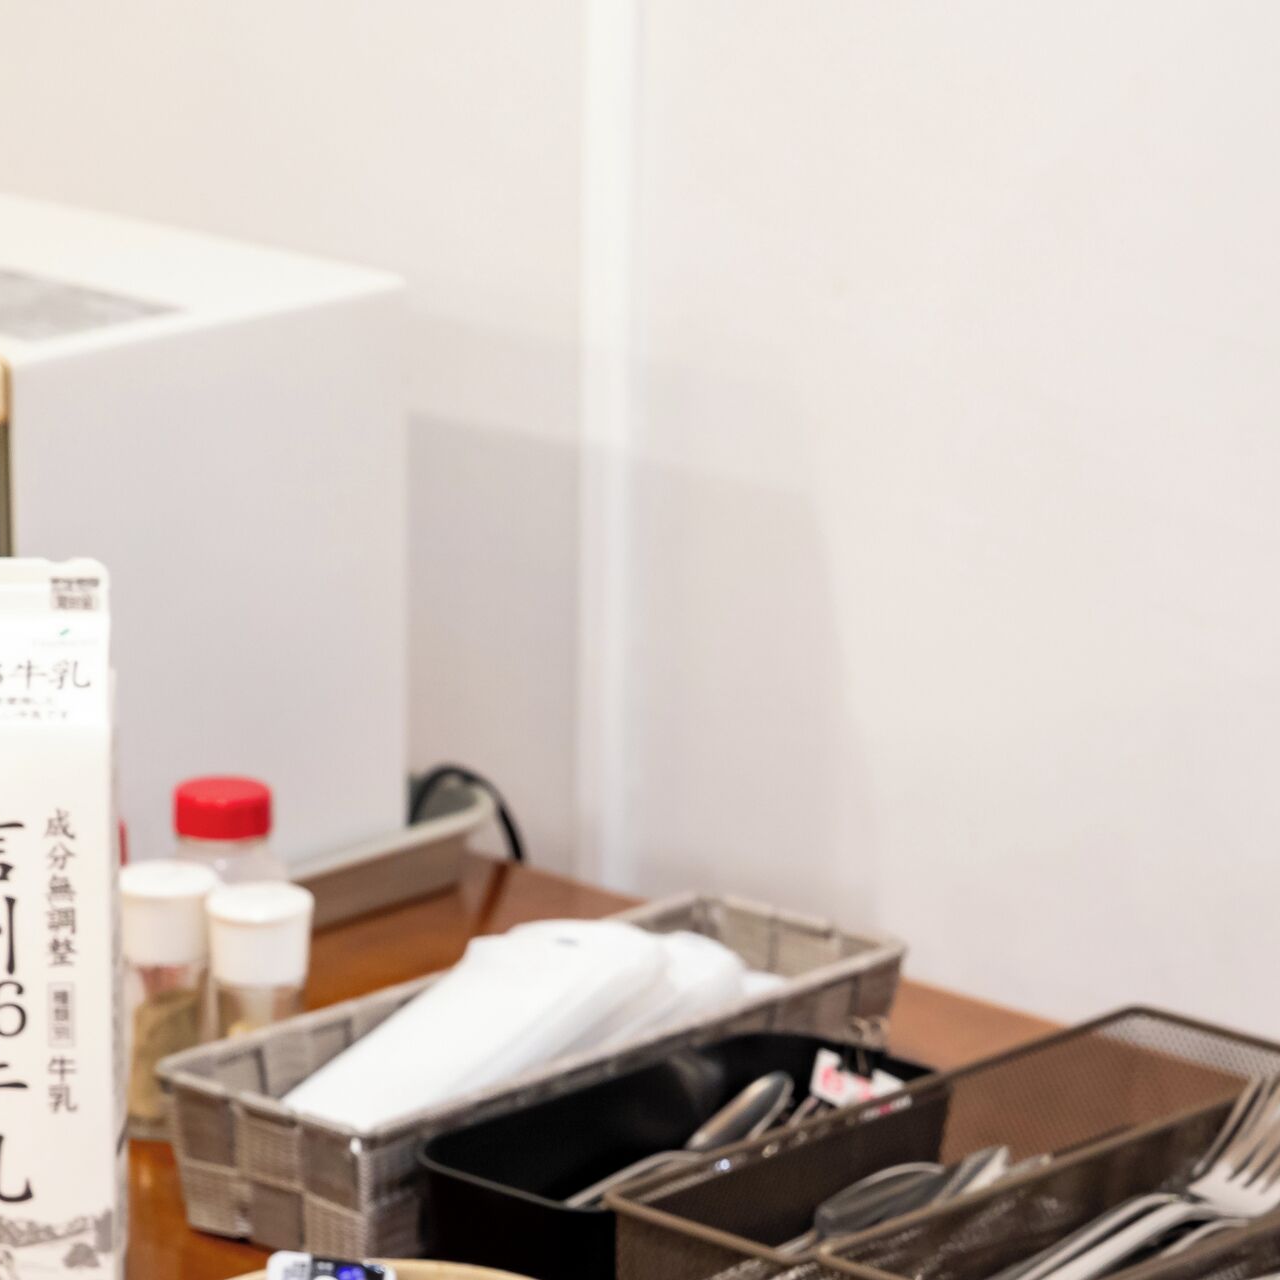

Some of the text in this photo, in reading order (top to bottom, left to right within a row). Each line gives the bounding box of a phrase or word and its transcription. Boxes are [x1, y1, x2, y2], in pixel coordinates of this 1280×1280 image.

[45, 808, 76, 967] 成分無調整
[47, 1055, 78, 1114] 牛乳
